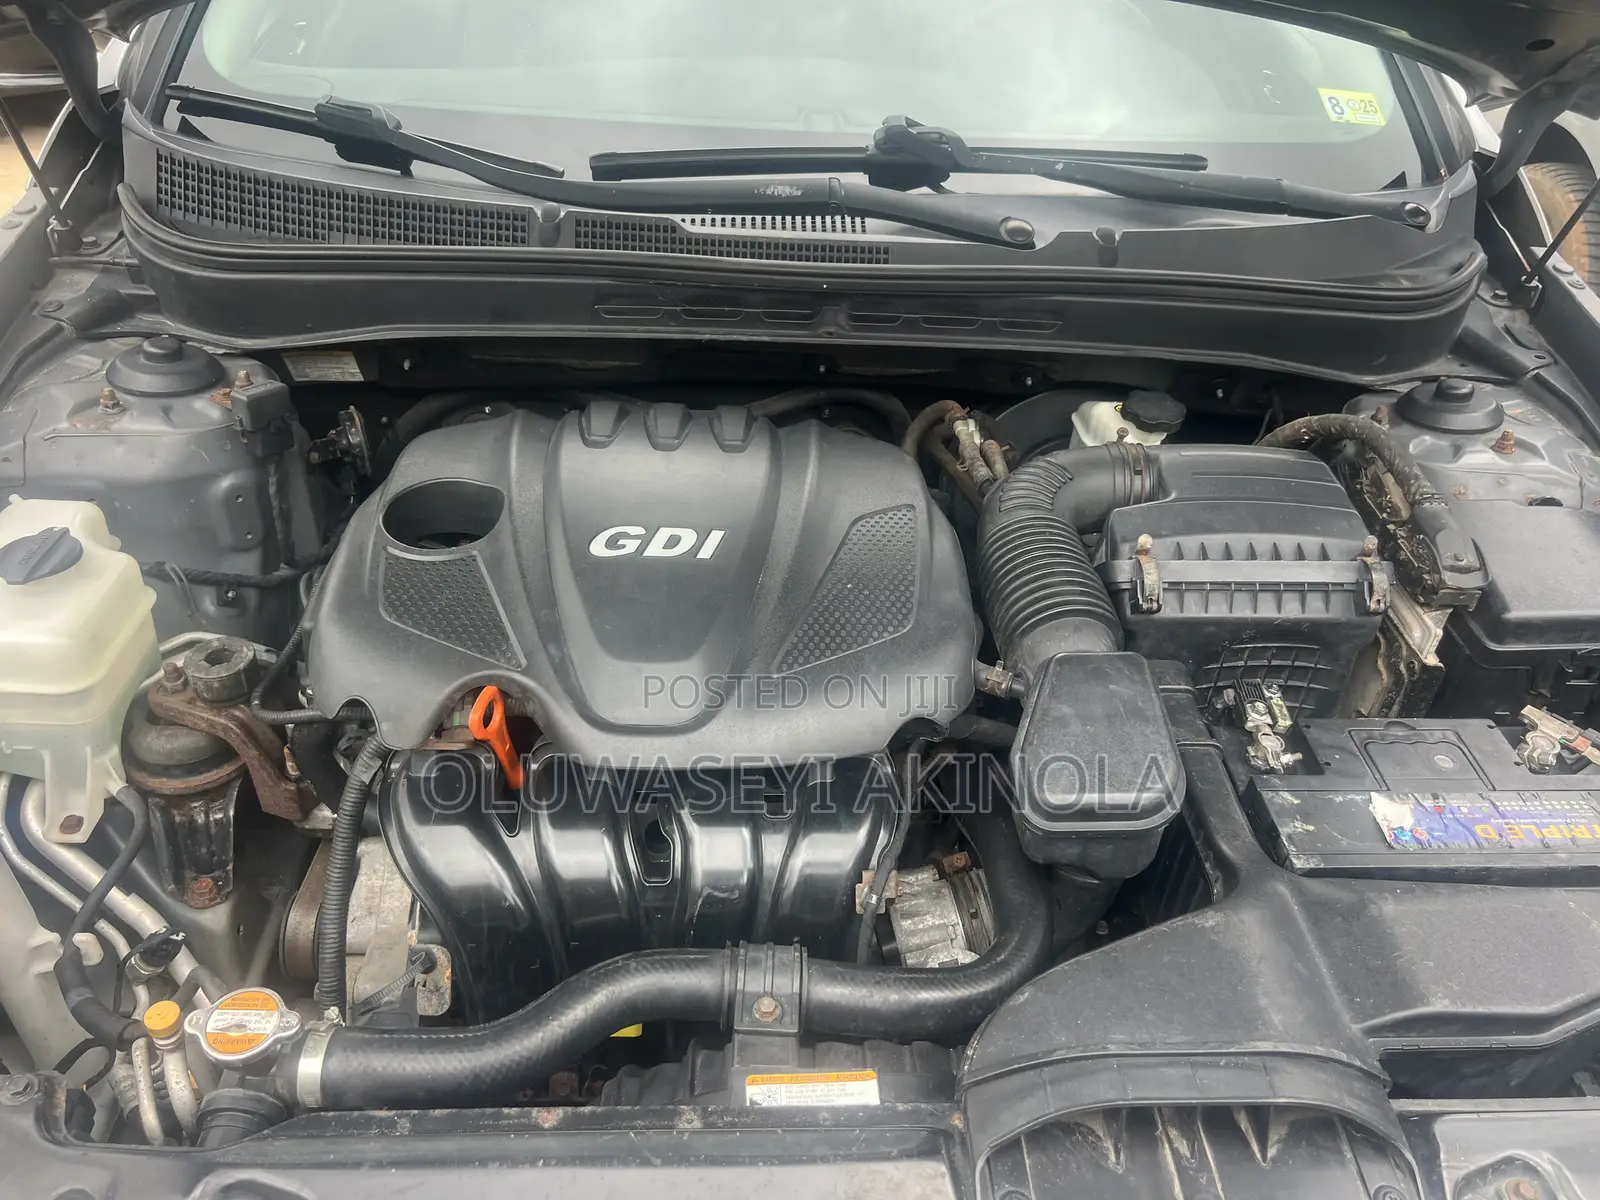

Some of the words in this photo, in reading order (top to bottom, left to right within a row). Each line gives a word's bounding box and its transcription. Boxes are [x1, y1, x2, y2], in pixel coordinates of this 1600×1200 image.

[1327, 96, 1345, 116] 8
[1359, 99, 1378, 114] 25
[588, 525, 726, 559] GDI
[1474, 824, 1499, 839] D
